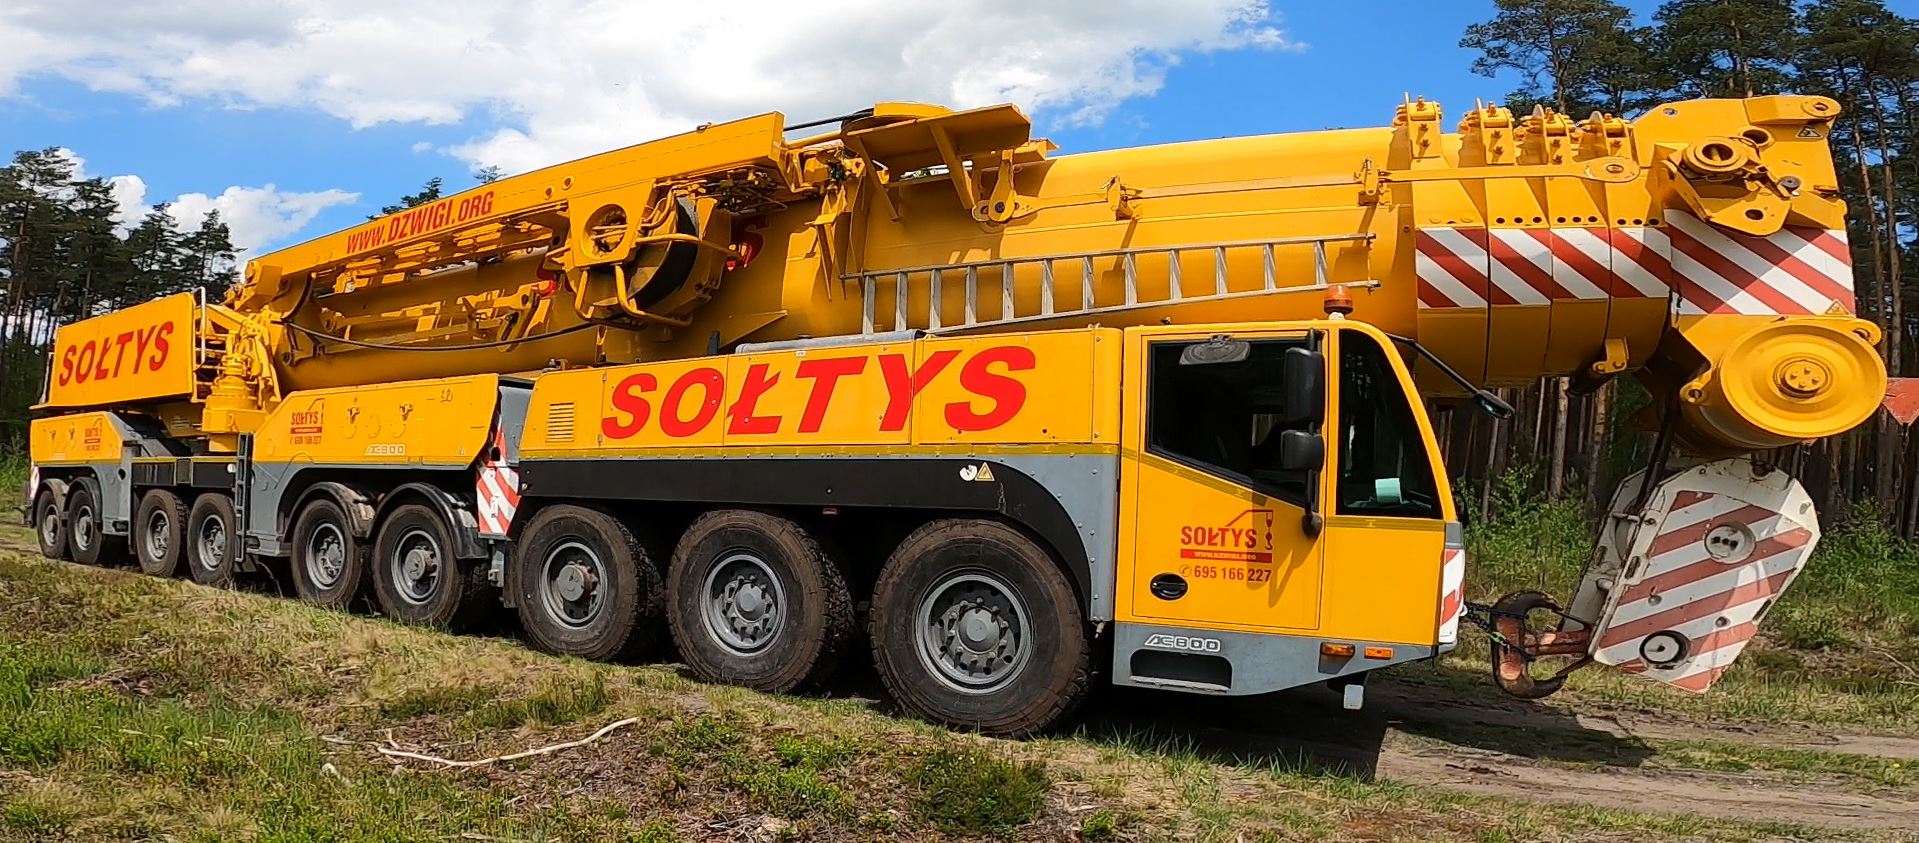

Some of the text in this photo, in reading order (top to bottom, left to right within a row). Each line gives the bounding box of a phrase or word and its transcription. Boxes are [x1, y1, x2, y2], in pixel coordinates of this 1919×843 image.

[346, 191, 494, 254] WWW.DZWIGI.ORG
[59, 321, 174, 387] SOŁTYS
[601, 345, 1036, 439] SOŁTYS
[1181, 526, 1257, 549] SOŁTYS
[1194, 565, 1271, 582] 695 166 227
